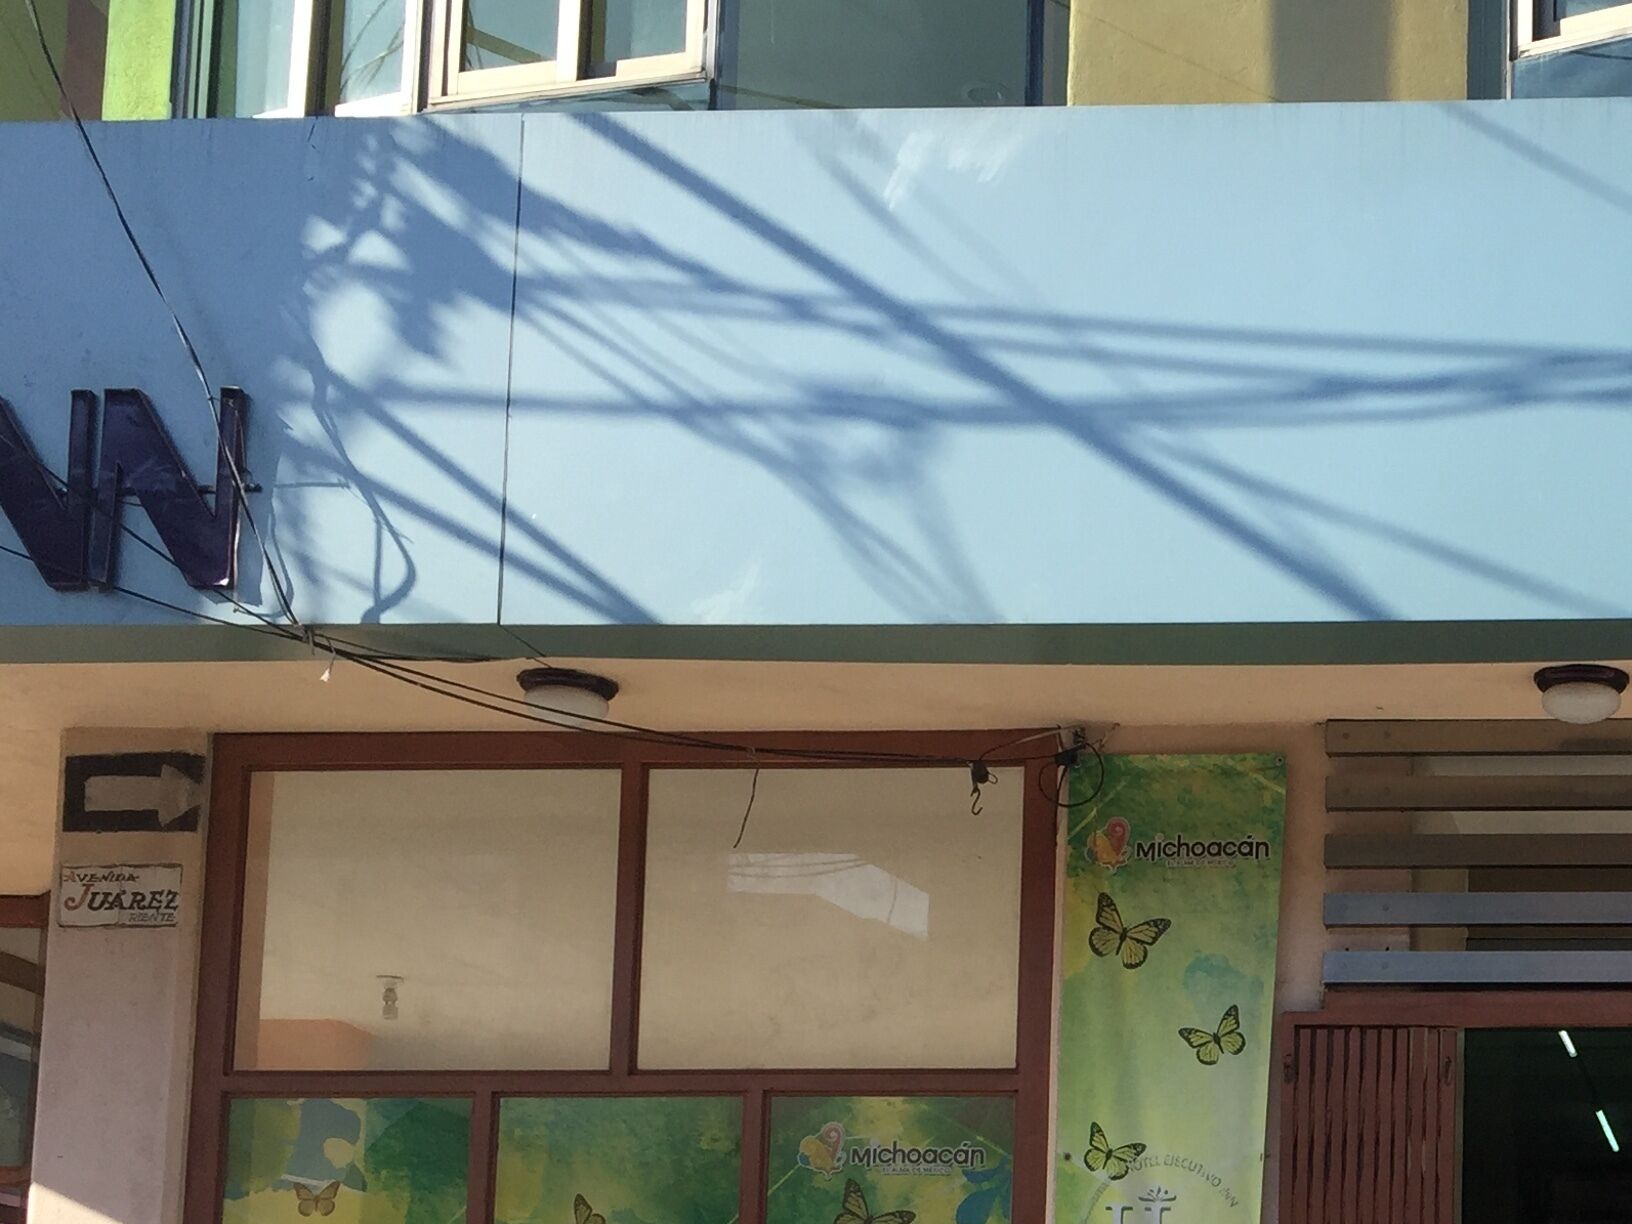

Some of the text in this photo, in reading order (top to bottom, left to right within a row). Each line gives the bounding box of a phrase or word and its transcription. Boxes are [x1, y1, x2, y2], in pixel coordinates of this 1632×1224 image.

[1135, 832, 1270, 862] Michoacán
[64, 870, 140, 883] AVENIDA
[64, 883, 180, 912] JUÁREZ
[850, 1138, 986, 1168] Michoacán
